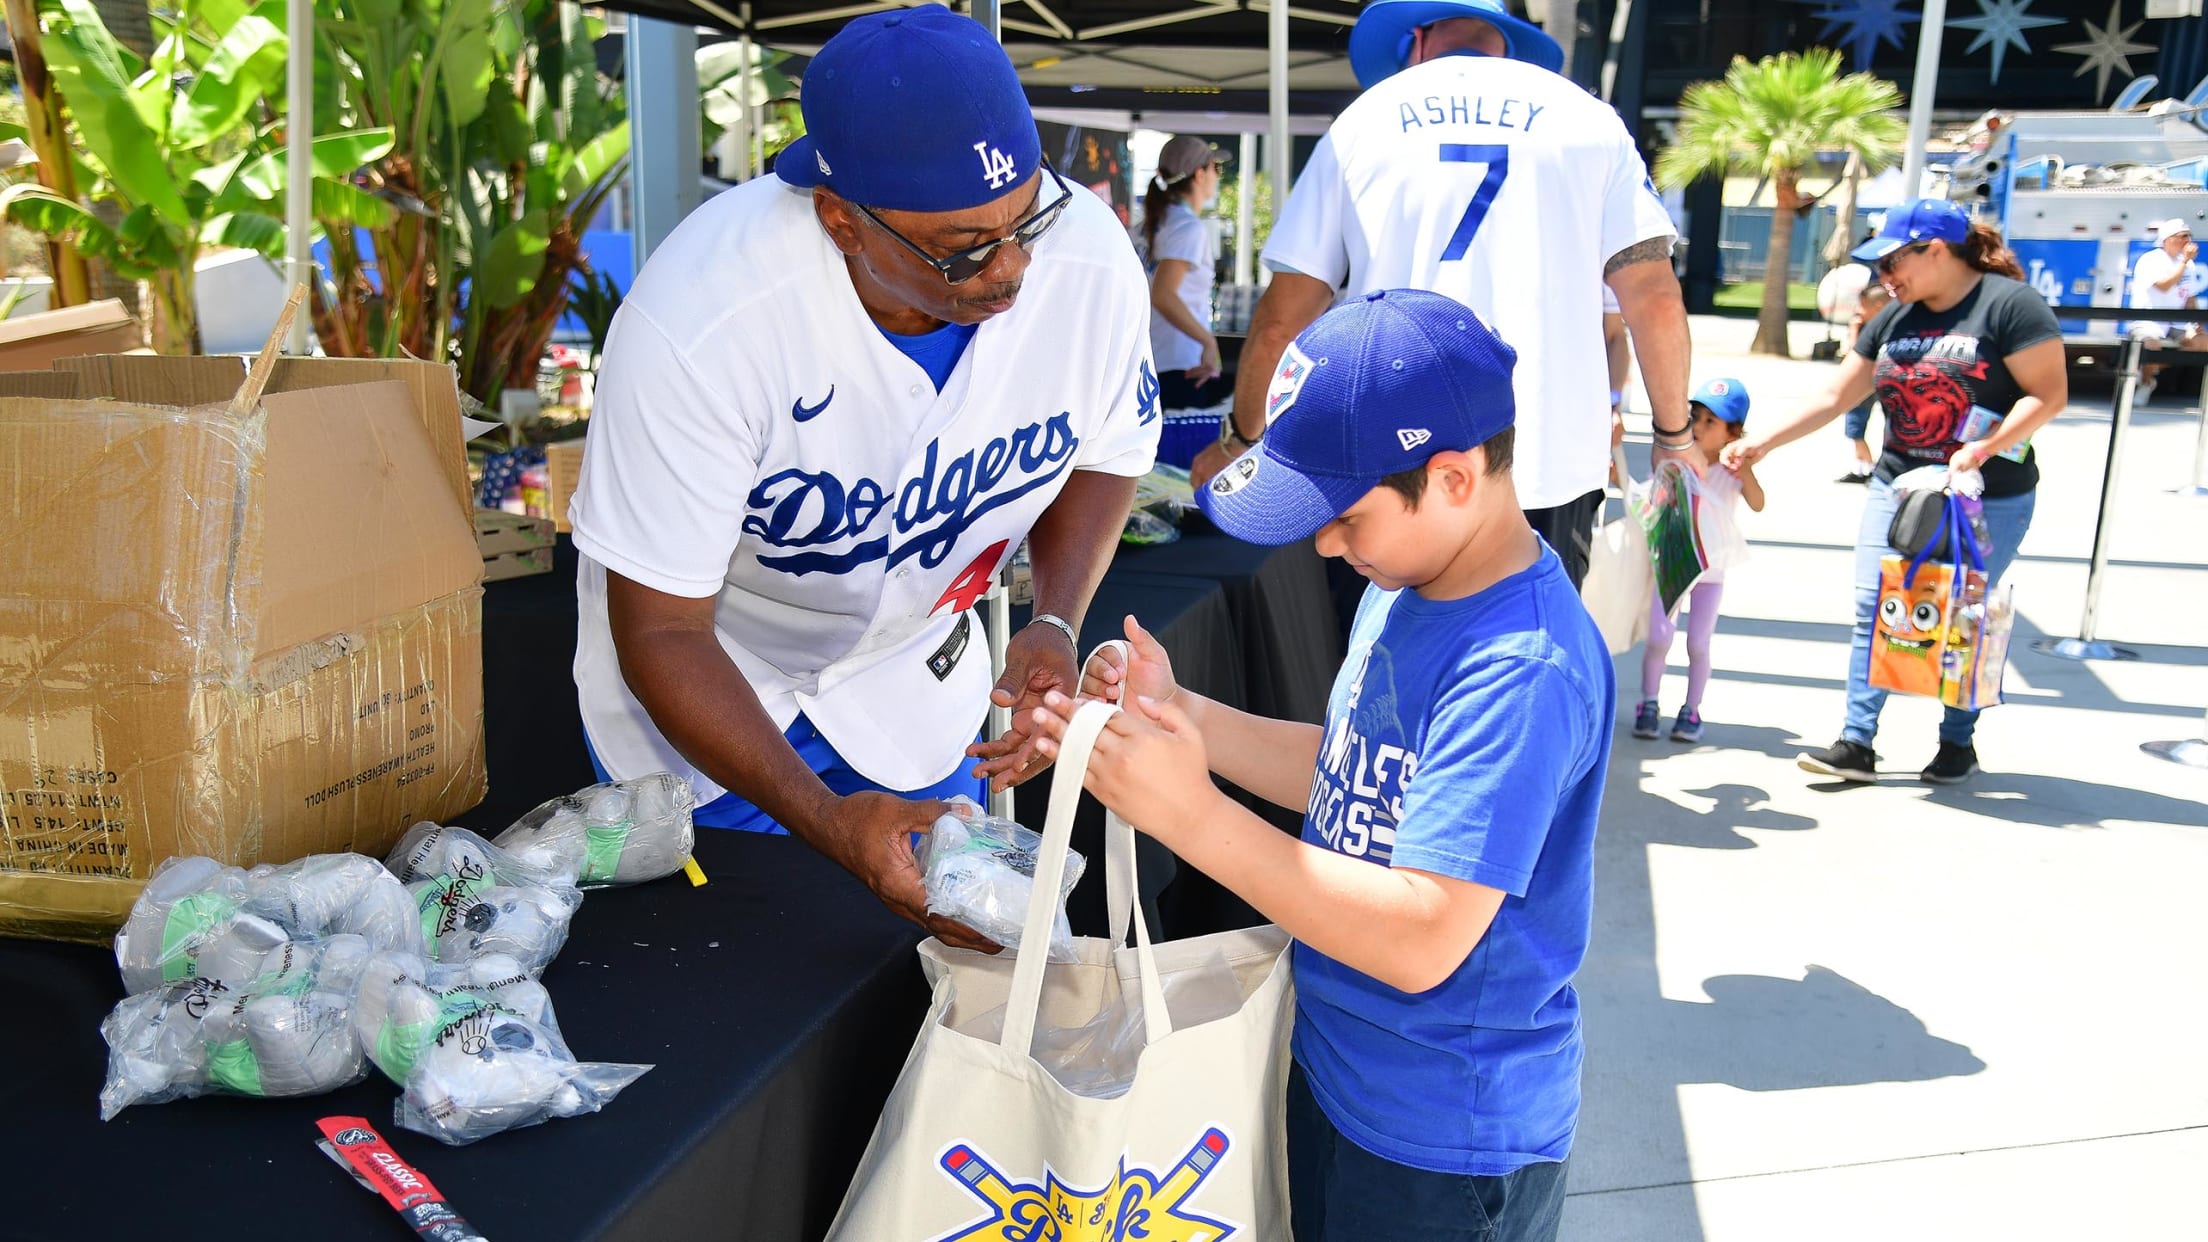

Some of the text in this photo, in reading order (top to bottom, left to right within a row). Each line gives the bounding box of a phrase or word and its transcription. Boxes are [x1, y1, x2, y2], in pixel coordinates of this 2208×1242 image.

[1399, 95, 1545, 133] ASHLEY
[972, 140, 1018, 191] LA
[1439, 143, 1509, 262] 7
[2028, 258, 2064, 307] LA
[741, 410, 1079, 576] Dodgers
[927, 538, 1011, 618] 4
[409, 722, 435, 741] PROMO
[304, 742, 435, 808] HEALTH AWARENESS PLUSH DOLL
[33, 816, 65, 828] 14.5
[15, 839, 127, 857] MADE IN CHINA
[400, 827, 443, 885] ental Health
[436, 855, 484, 938] Dodgers
[371, 1152, 424, 1190] CLASSIC
[1056, 1193, 1074, 1224] LA
